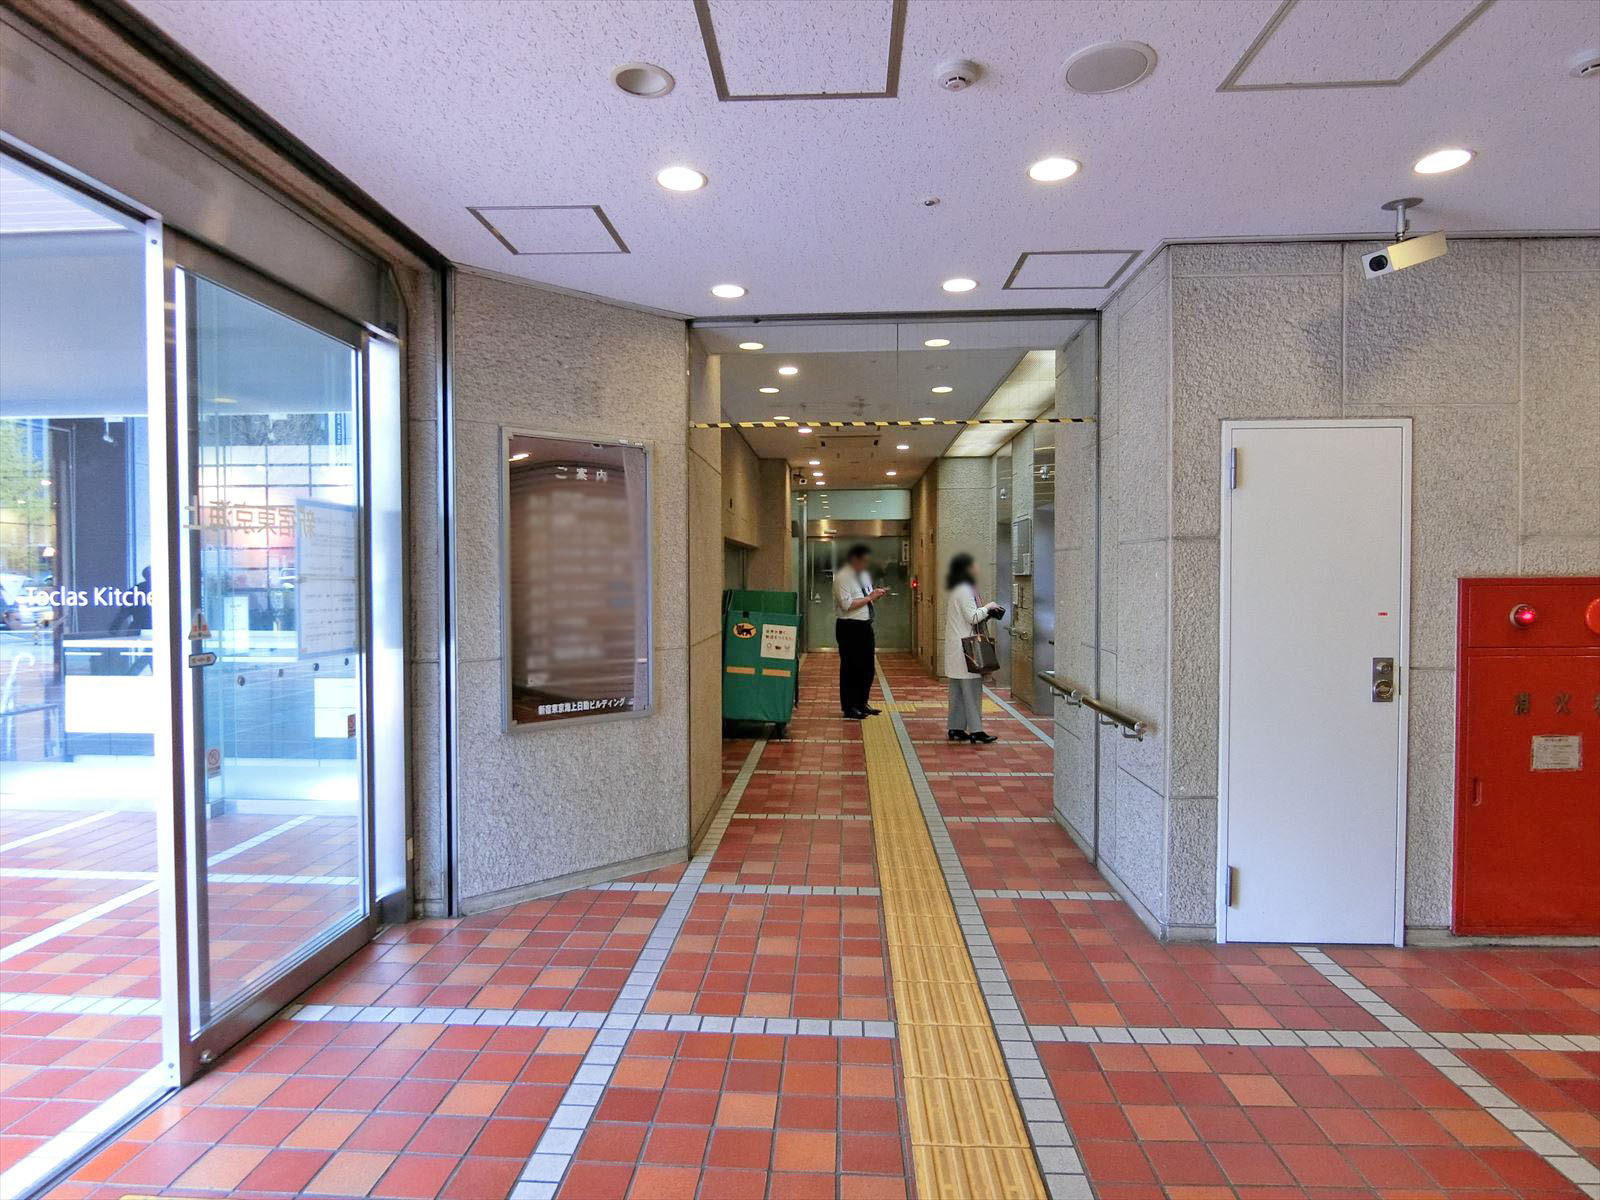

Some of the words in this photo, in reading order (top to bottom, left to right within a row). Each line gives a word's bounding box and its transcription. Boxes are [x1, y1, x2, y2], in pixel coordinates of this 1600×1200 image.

[555, 466, 608, 482] ご案内
[24, 586, 88, 607] Toclas
